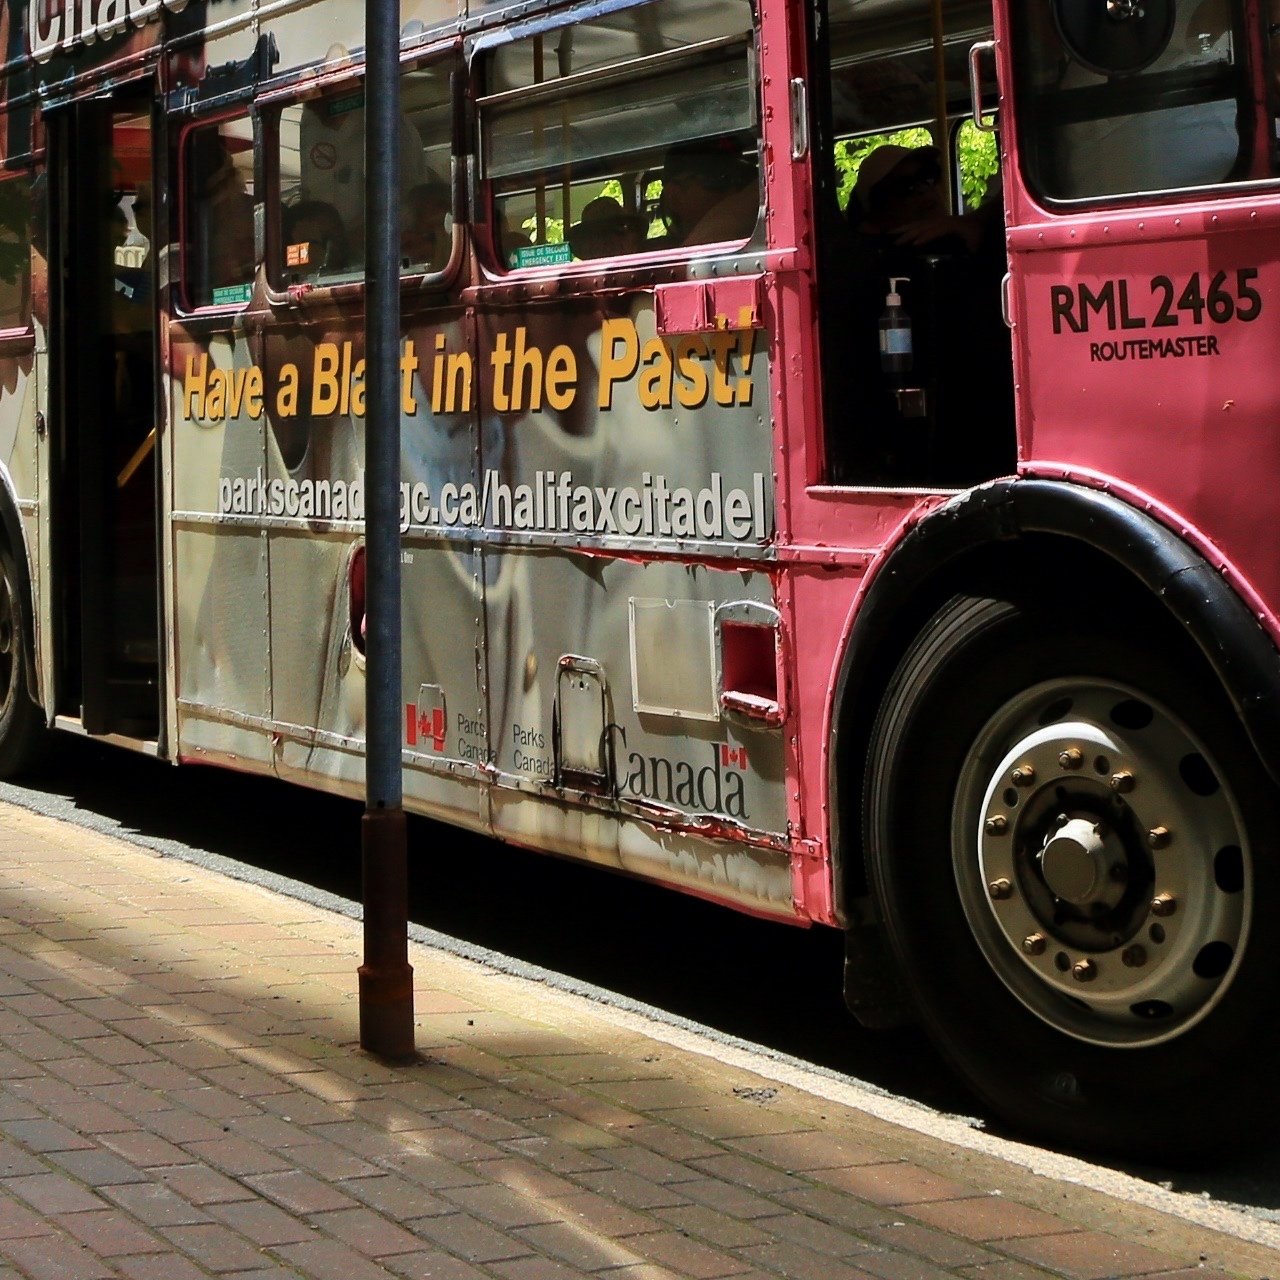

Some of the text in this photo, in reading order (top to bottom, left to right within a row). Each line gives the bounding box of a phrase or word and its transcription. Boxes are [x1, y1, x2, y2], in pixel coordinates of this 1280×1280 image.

[1050, 267, 1262, 335] RML 2465
[184, 304, 757, 420] Have a Blat in the Past!
[1089, 334, 1220, 362] ROUTEMASTER
[457, 713, 486, 738] Parcs
[513, 723, 546, 750] Parks
[458, 737, 498, 764] Canada
[513, 749, 556, 777] Canada
[600, 722, 750, 820] Canada
